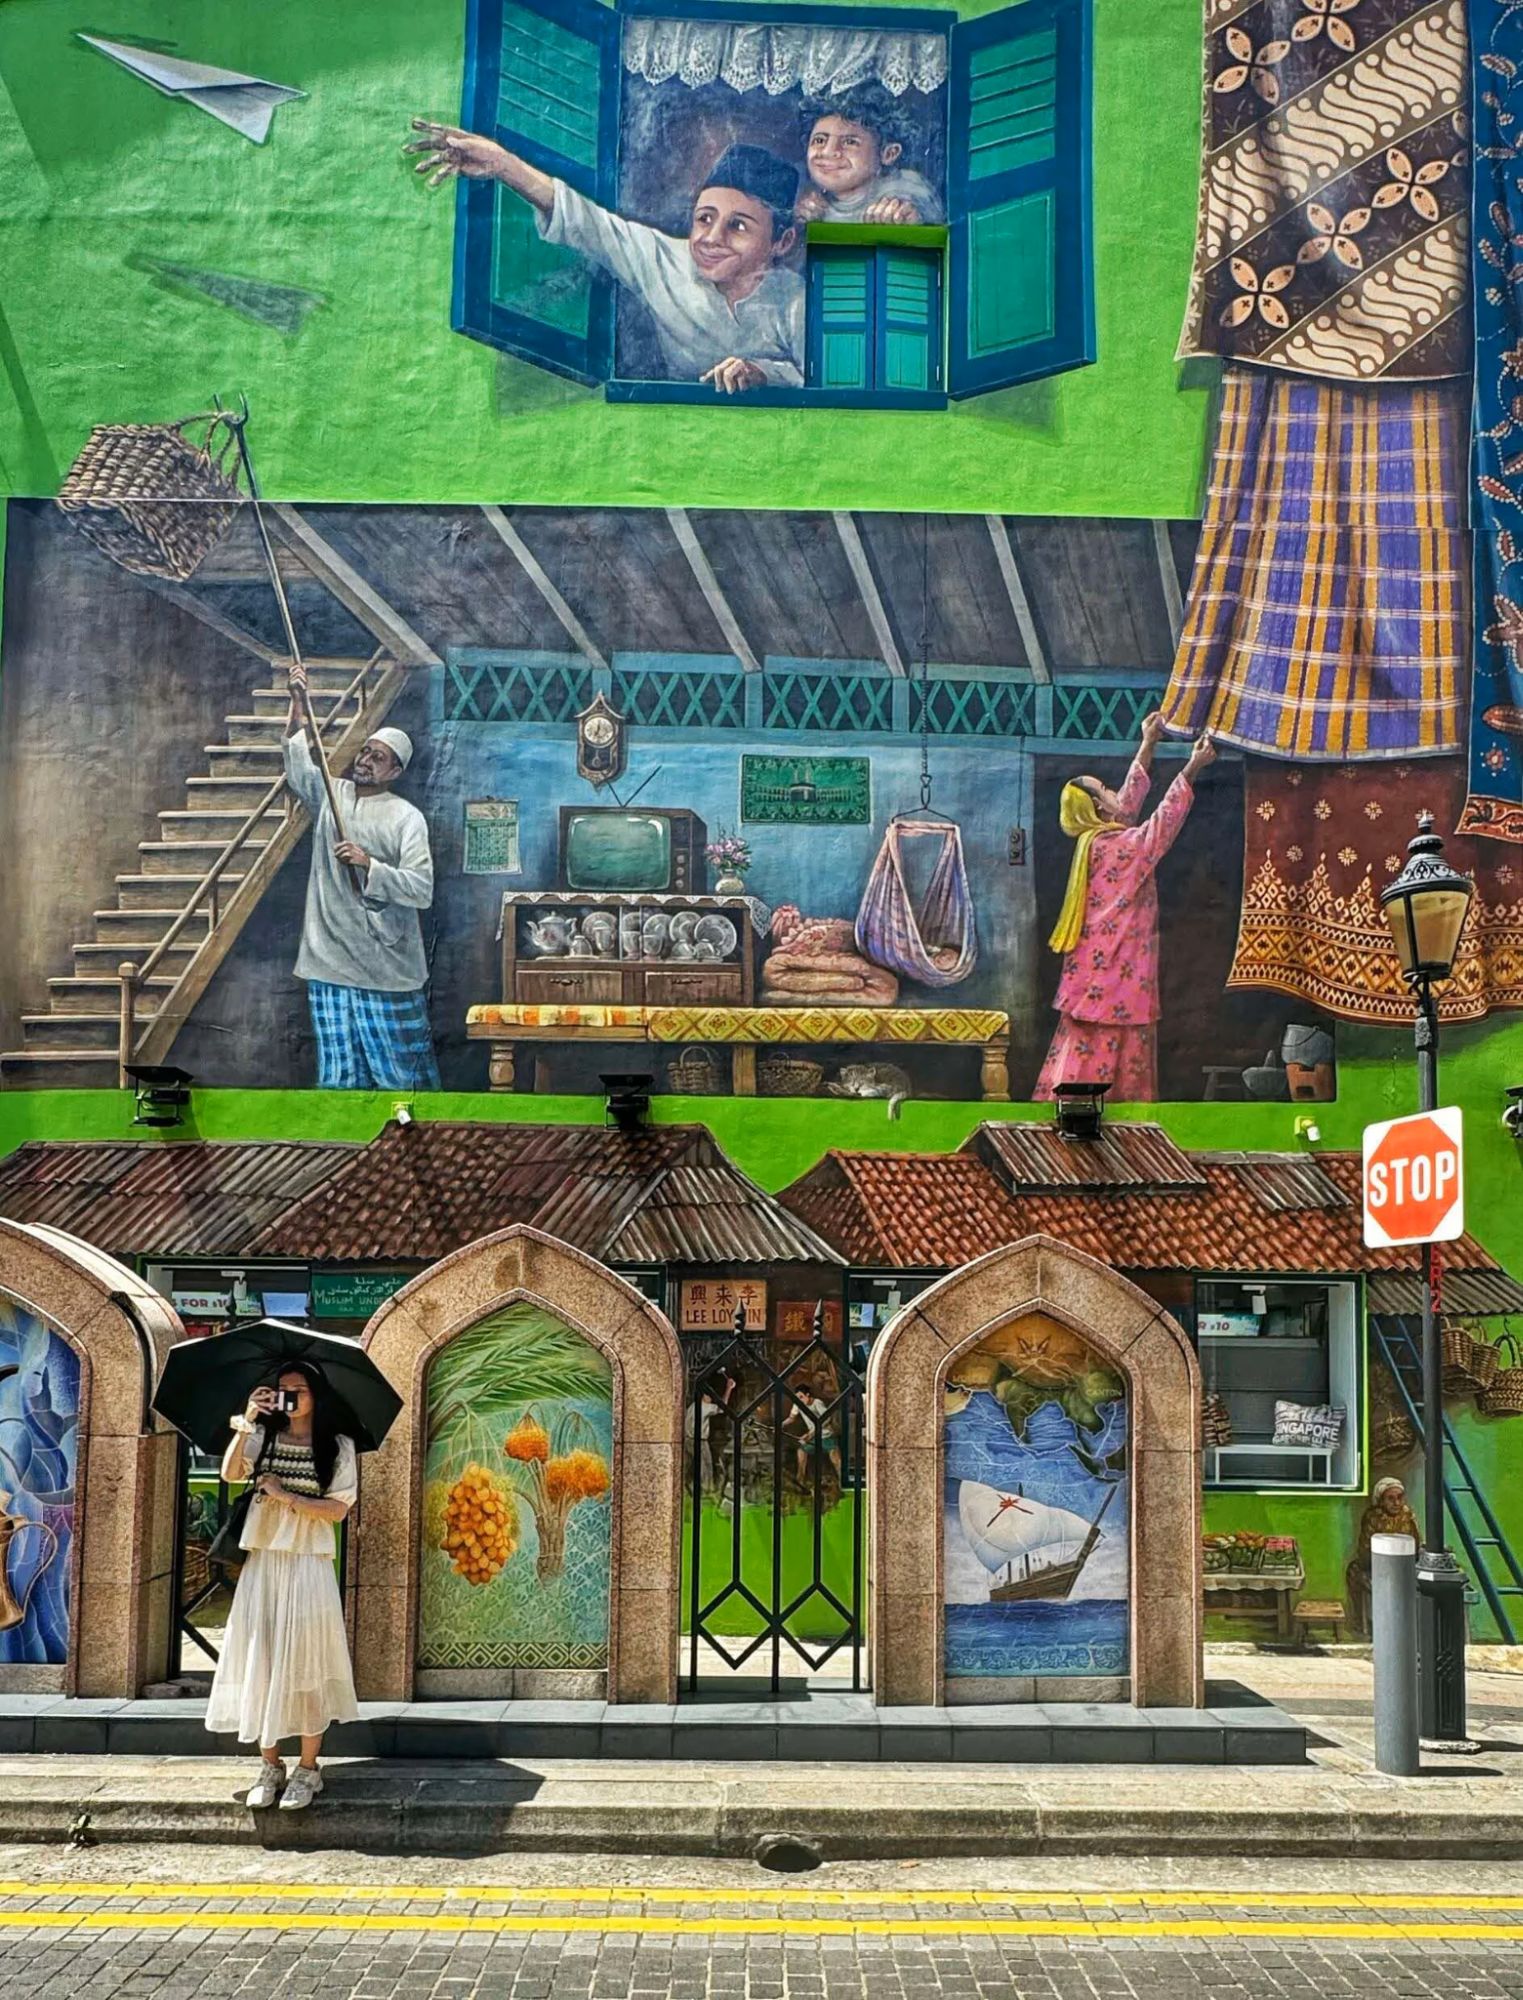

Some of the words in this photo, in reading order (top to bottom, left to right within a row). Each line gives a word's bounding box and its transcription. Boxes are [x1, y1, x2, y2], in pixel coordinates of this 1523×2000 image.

[1369, 1150, 1456, 1208] STOP
[182, 1298, 208, 1308] FOR
[686, 1309, 707, 1324] LEE
[712, 1309, 734, 1324] LOY
